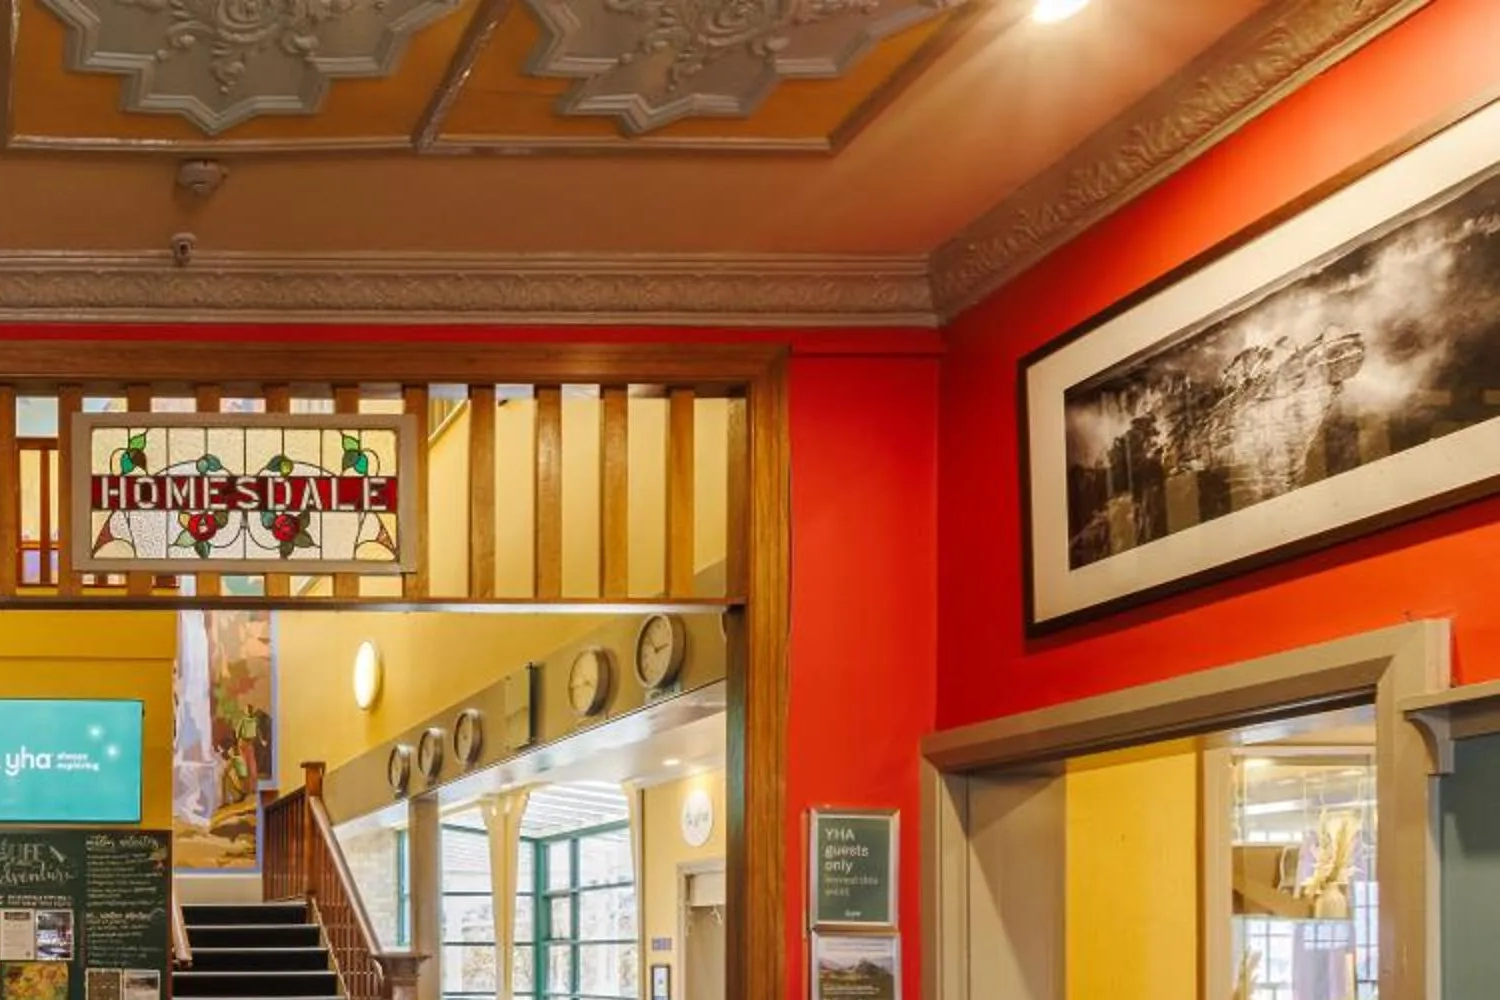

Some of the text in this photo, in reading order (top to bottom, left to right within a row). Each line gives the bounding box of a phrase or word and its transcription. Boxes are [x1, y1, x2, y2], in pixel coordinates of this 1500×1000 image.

[101, 477, 388, 511] HOMESDALE
[5, 745, 51, 776] yha
[824, 828, 856, 841] YHA
[824, 844, 870, 859] guests
[824, 860, 853, 874] only
